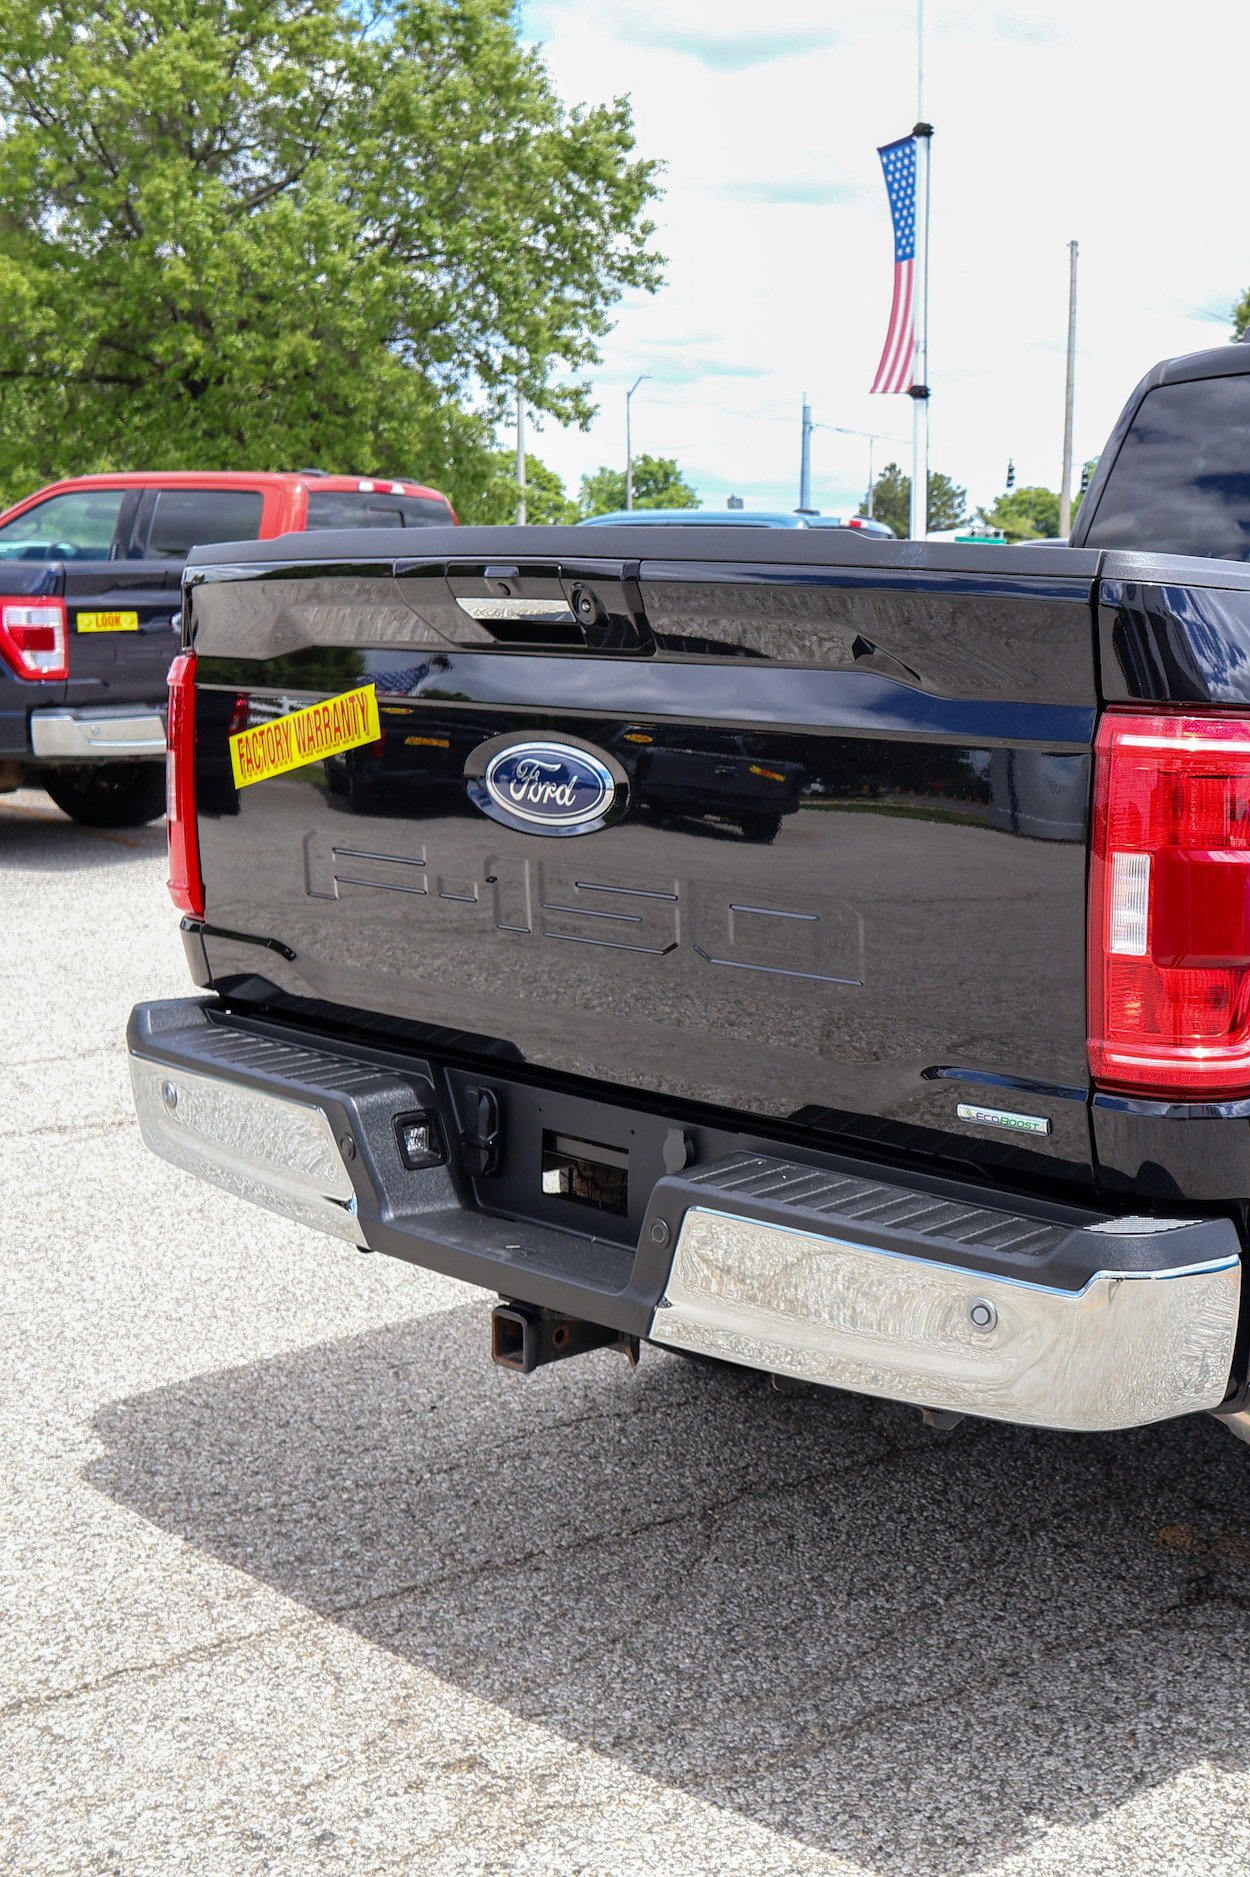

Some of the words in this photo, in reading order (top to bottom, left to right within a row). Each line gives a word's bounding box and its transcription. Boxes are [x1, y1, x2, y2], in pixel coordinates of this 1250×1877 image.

[95, 612, 121, 628] LOOK
[237, 720, 293, 779] FACTORY
[293, 692, 369, 758] WARRANTY
[510, 758, 579, 806] Ford
[305, 829, 866, 987] F-150
